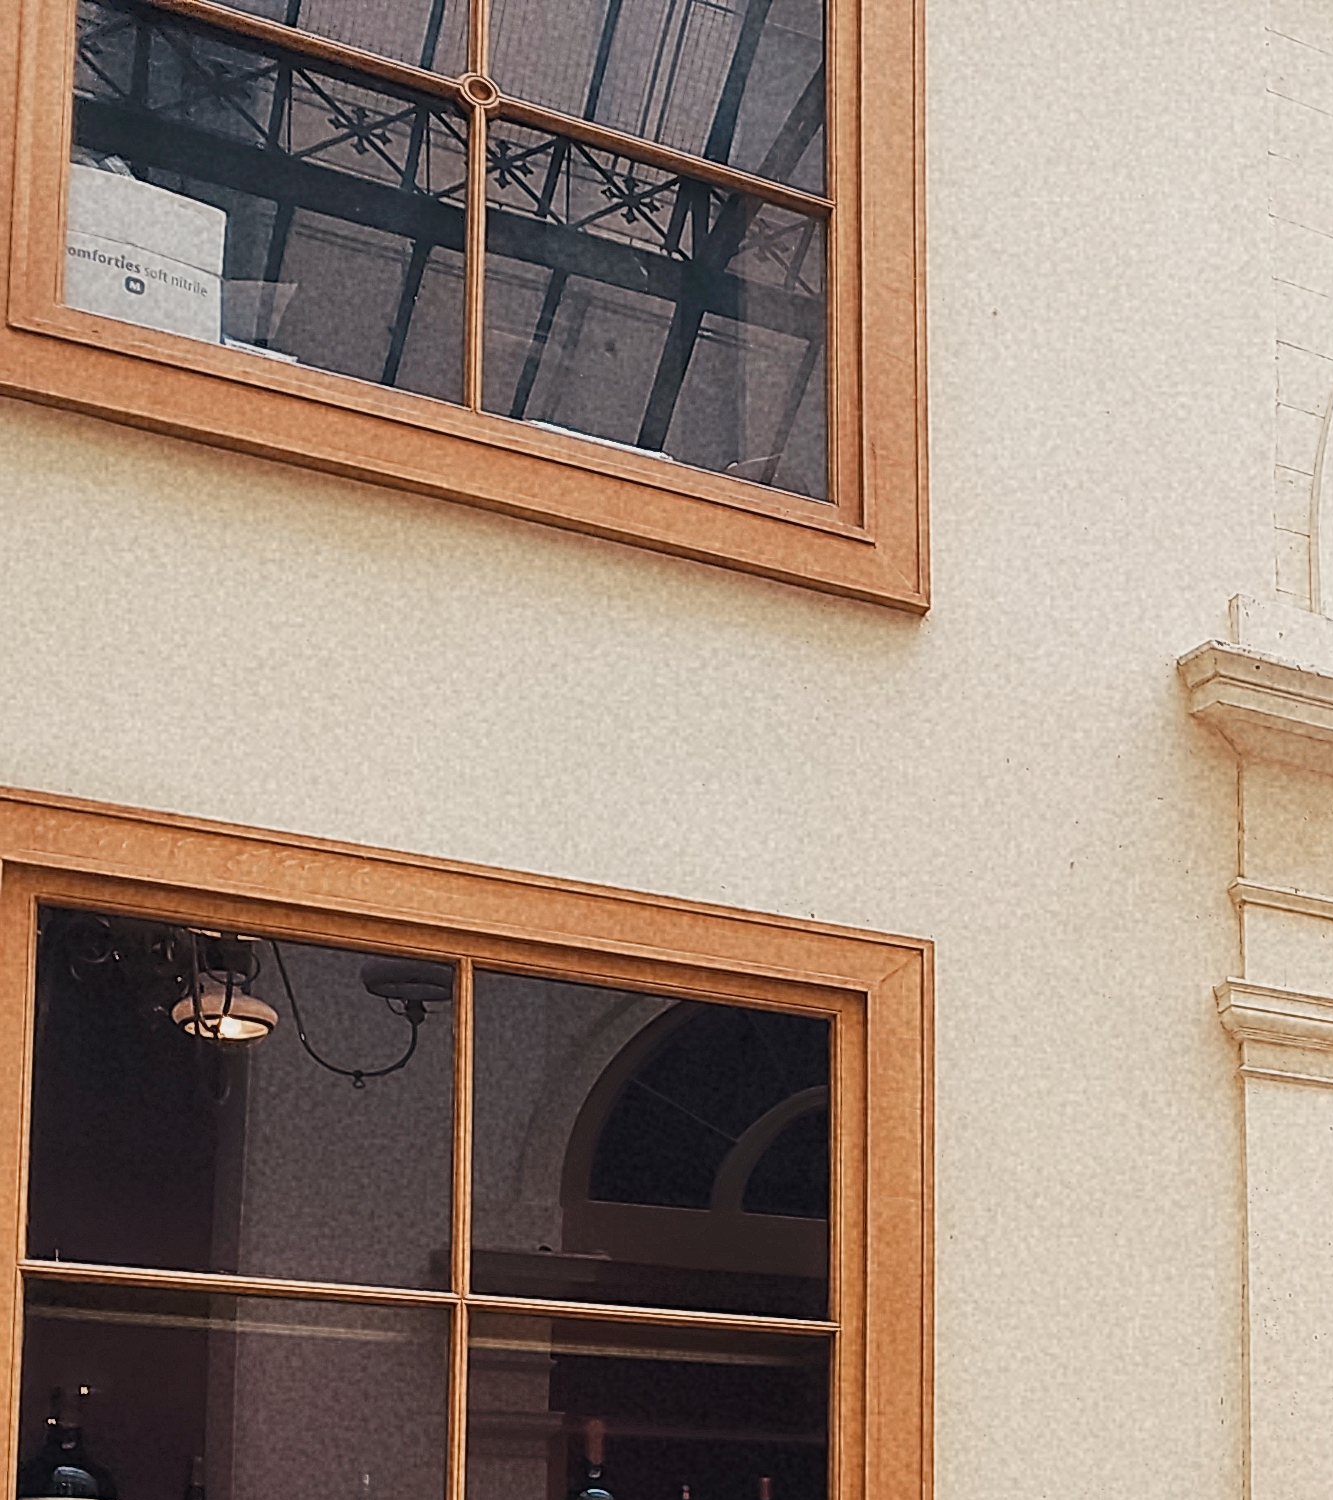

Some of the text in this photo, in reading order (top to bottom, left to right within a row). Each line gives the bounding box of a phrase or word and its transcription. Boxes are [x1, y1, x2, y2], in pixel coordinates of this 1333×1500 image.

[66, 246, 208, 297] omforties soft nitrile
